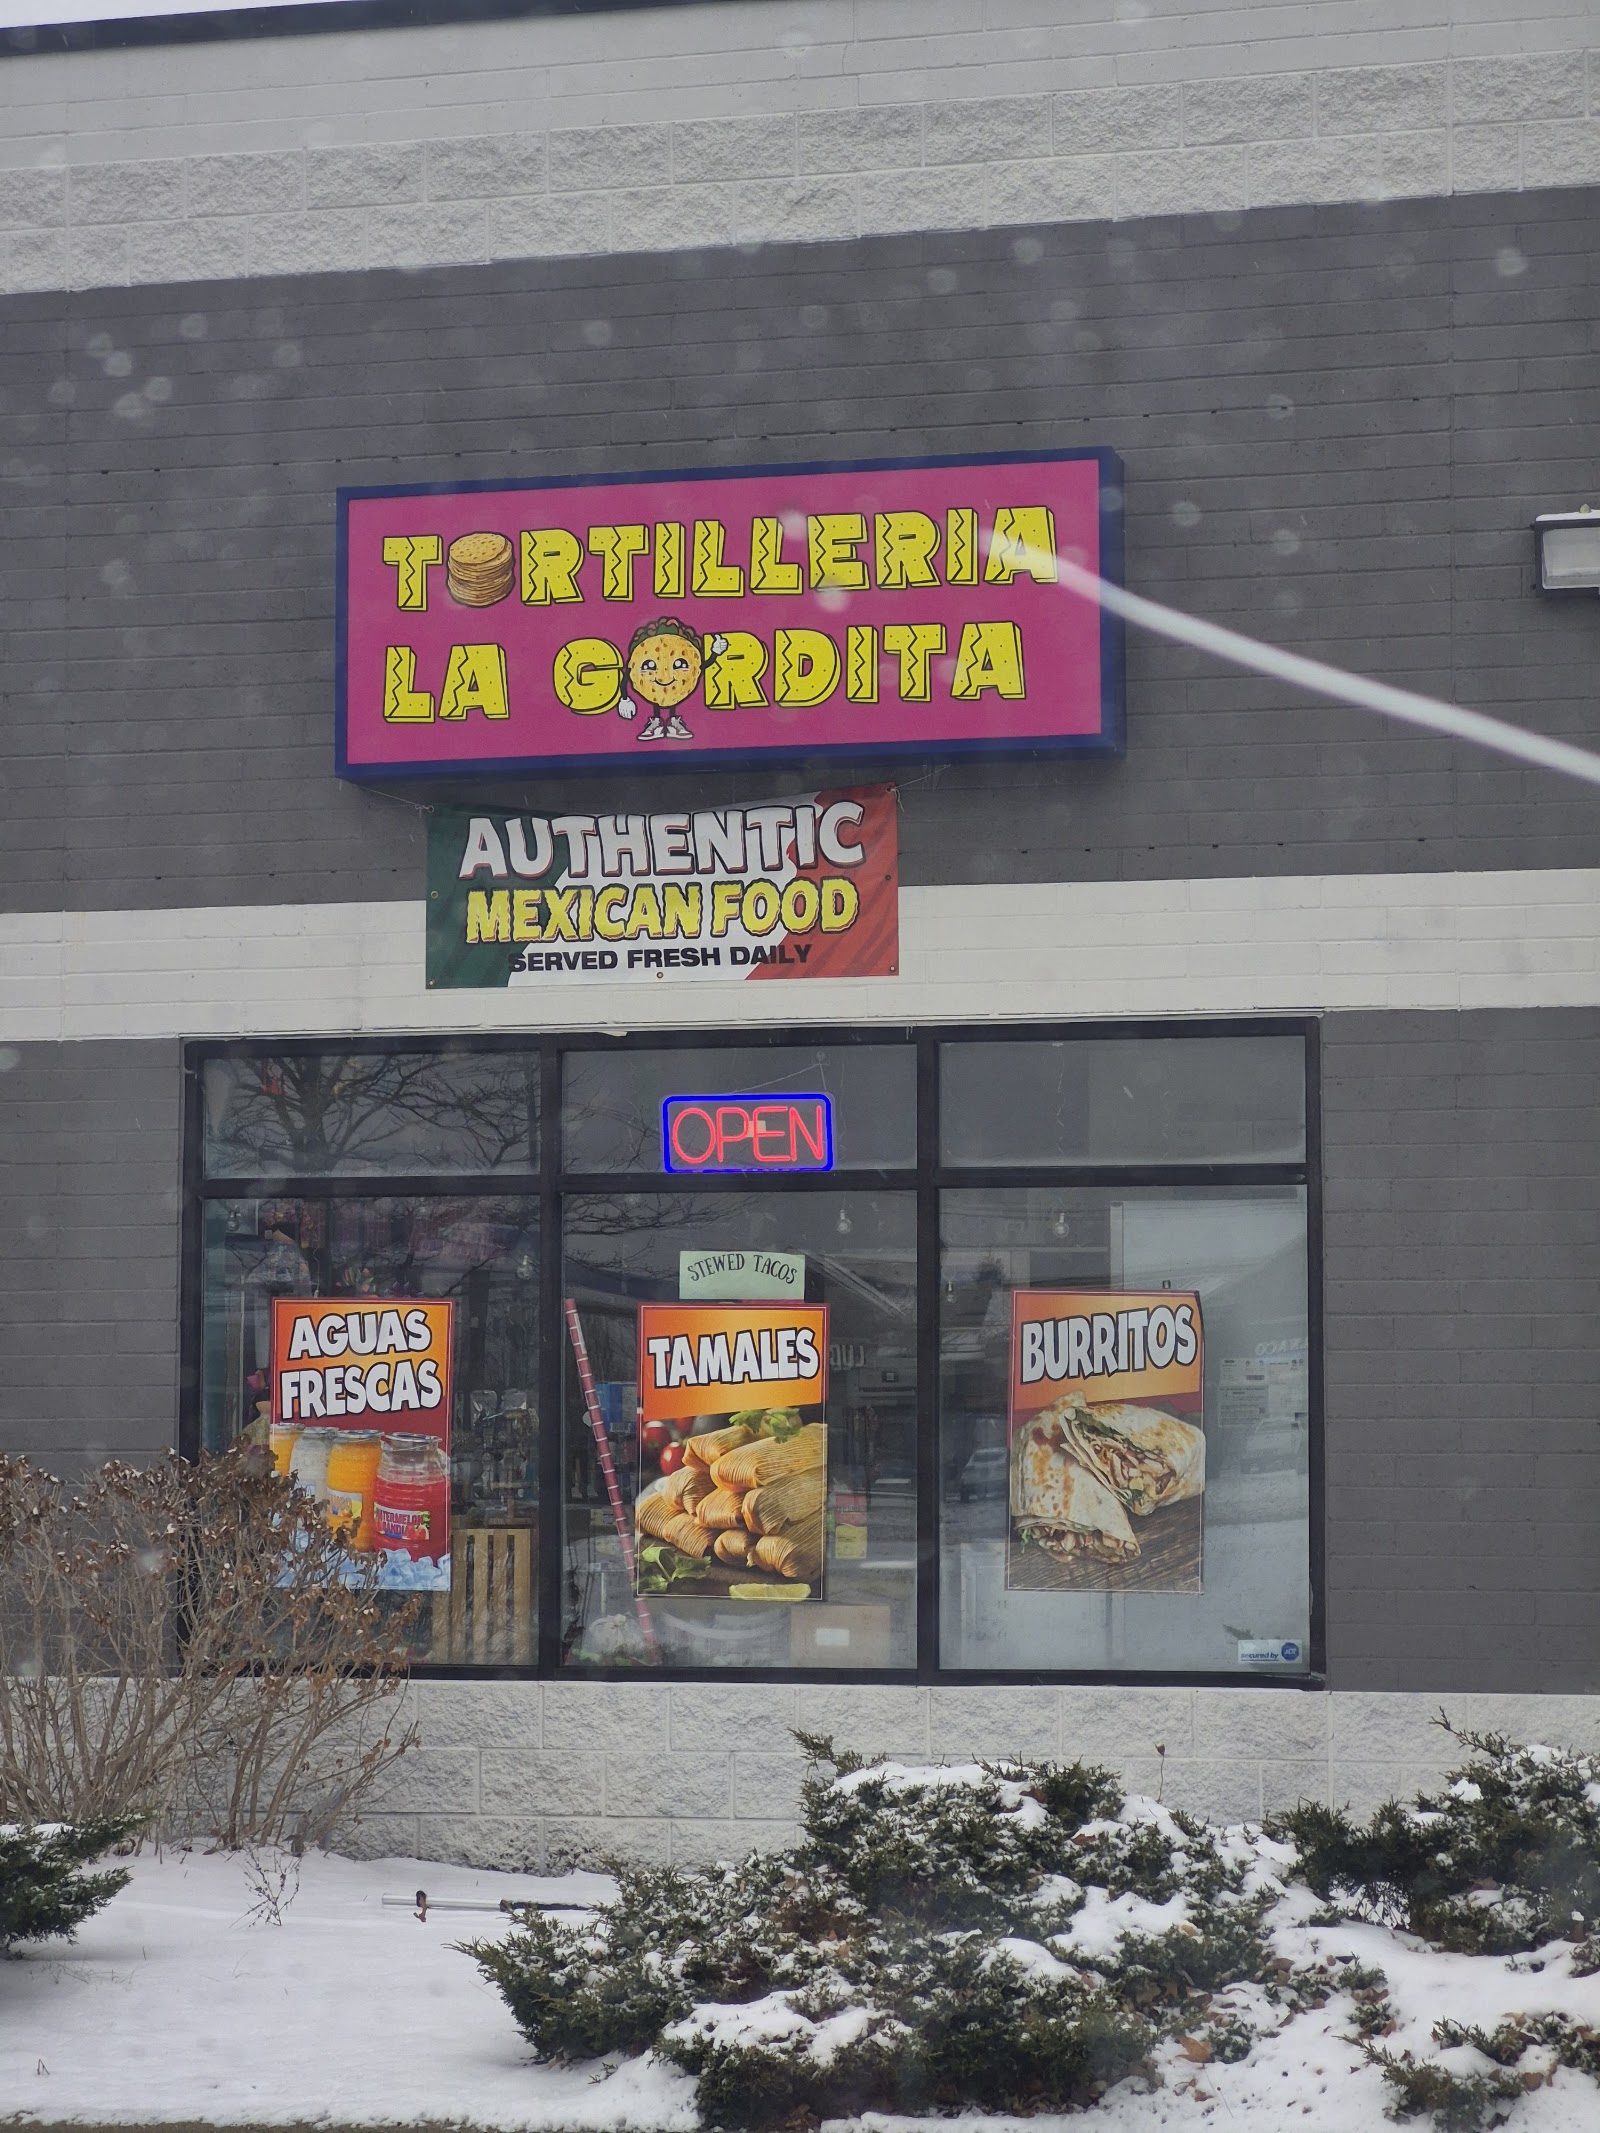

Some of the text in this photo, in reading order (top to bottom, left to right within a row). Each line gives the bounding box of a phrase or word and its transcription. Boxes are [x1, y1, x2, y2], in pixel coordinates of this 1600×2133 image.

[384, 643, 510, 723] LA
[459, 801, 865, 880] AUTHENTIC
[465, 876, 860, 945] MEXICAN FOOD
[509, 944, 813, 973] SERVED FRESH DAILY
[672, 1105, 824, 1163] OPEN
[687, 1253, 797, 1284] STEWED TACOS
[289, 1308, 432, 1360] AGUAS
[648, 1327, 821, 1390] TAMALES
[1020, 1303, 1197, 1386] BURRITOS
[280, 1359, 442, 1421] FRESCAS
